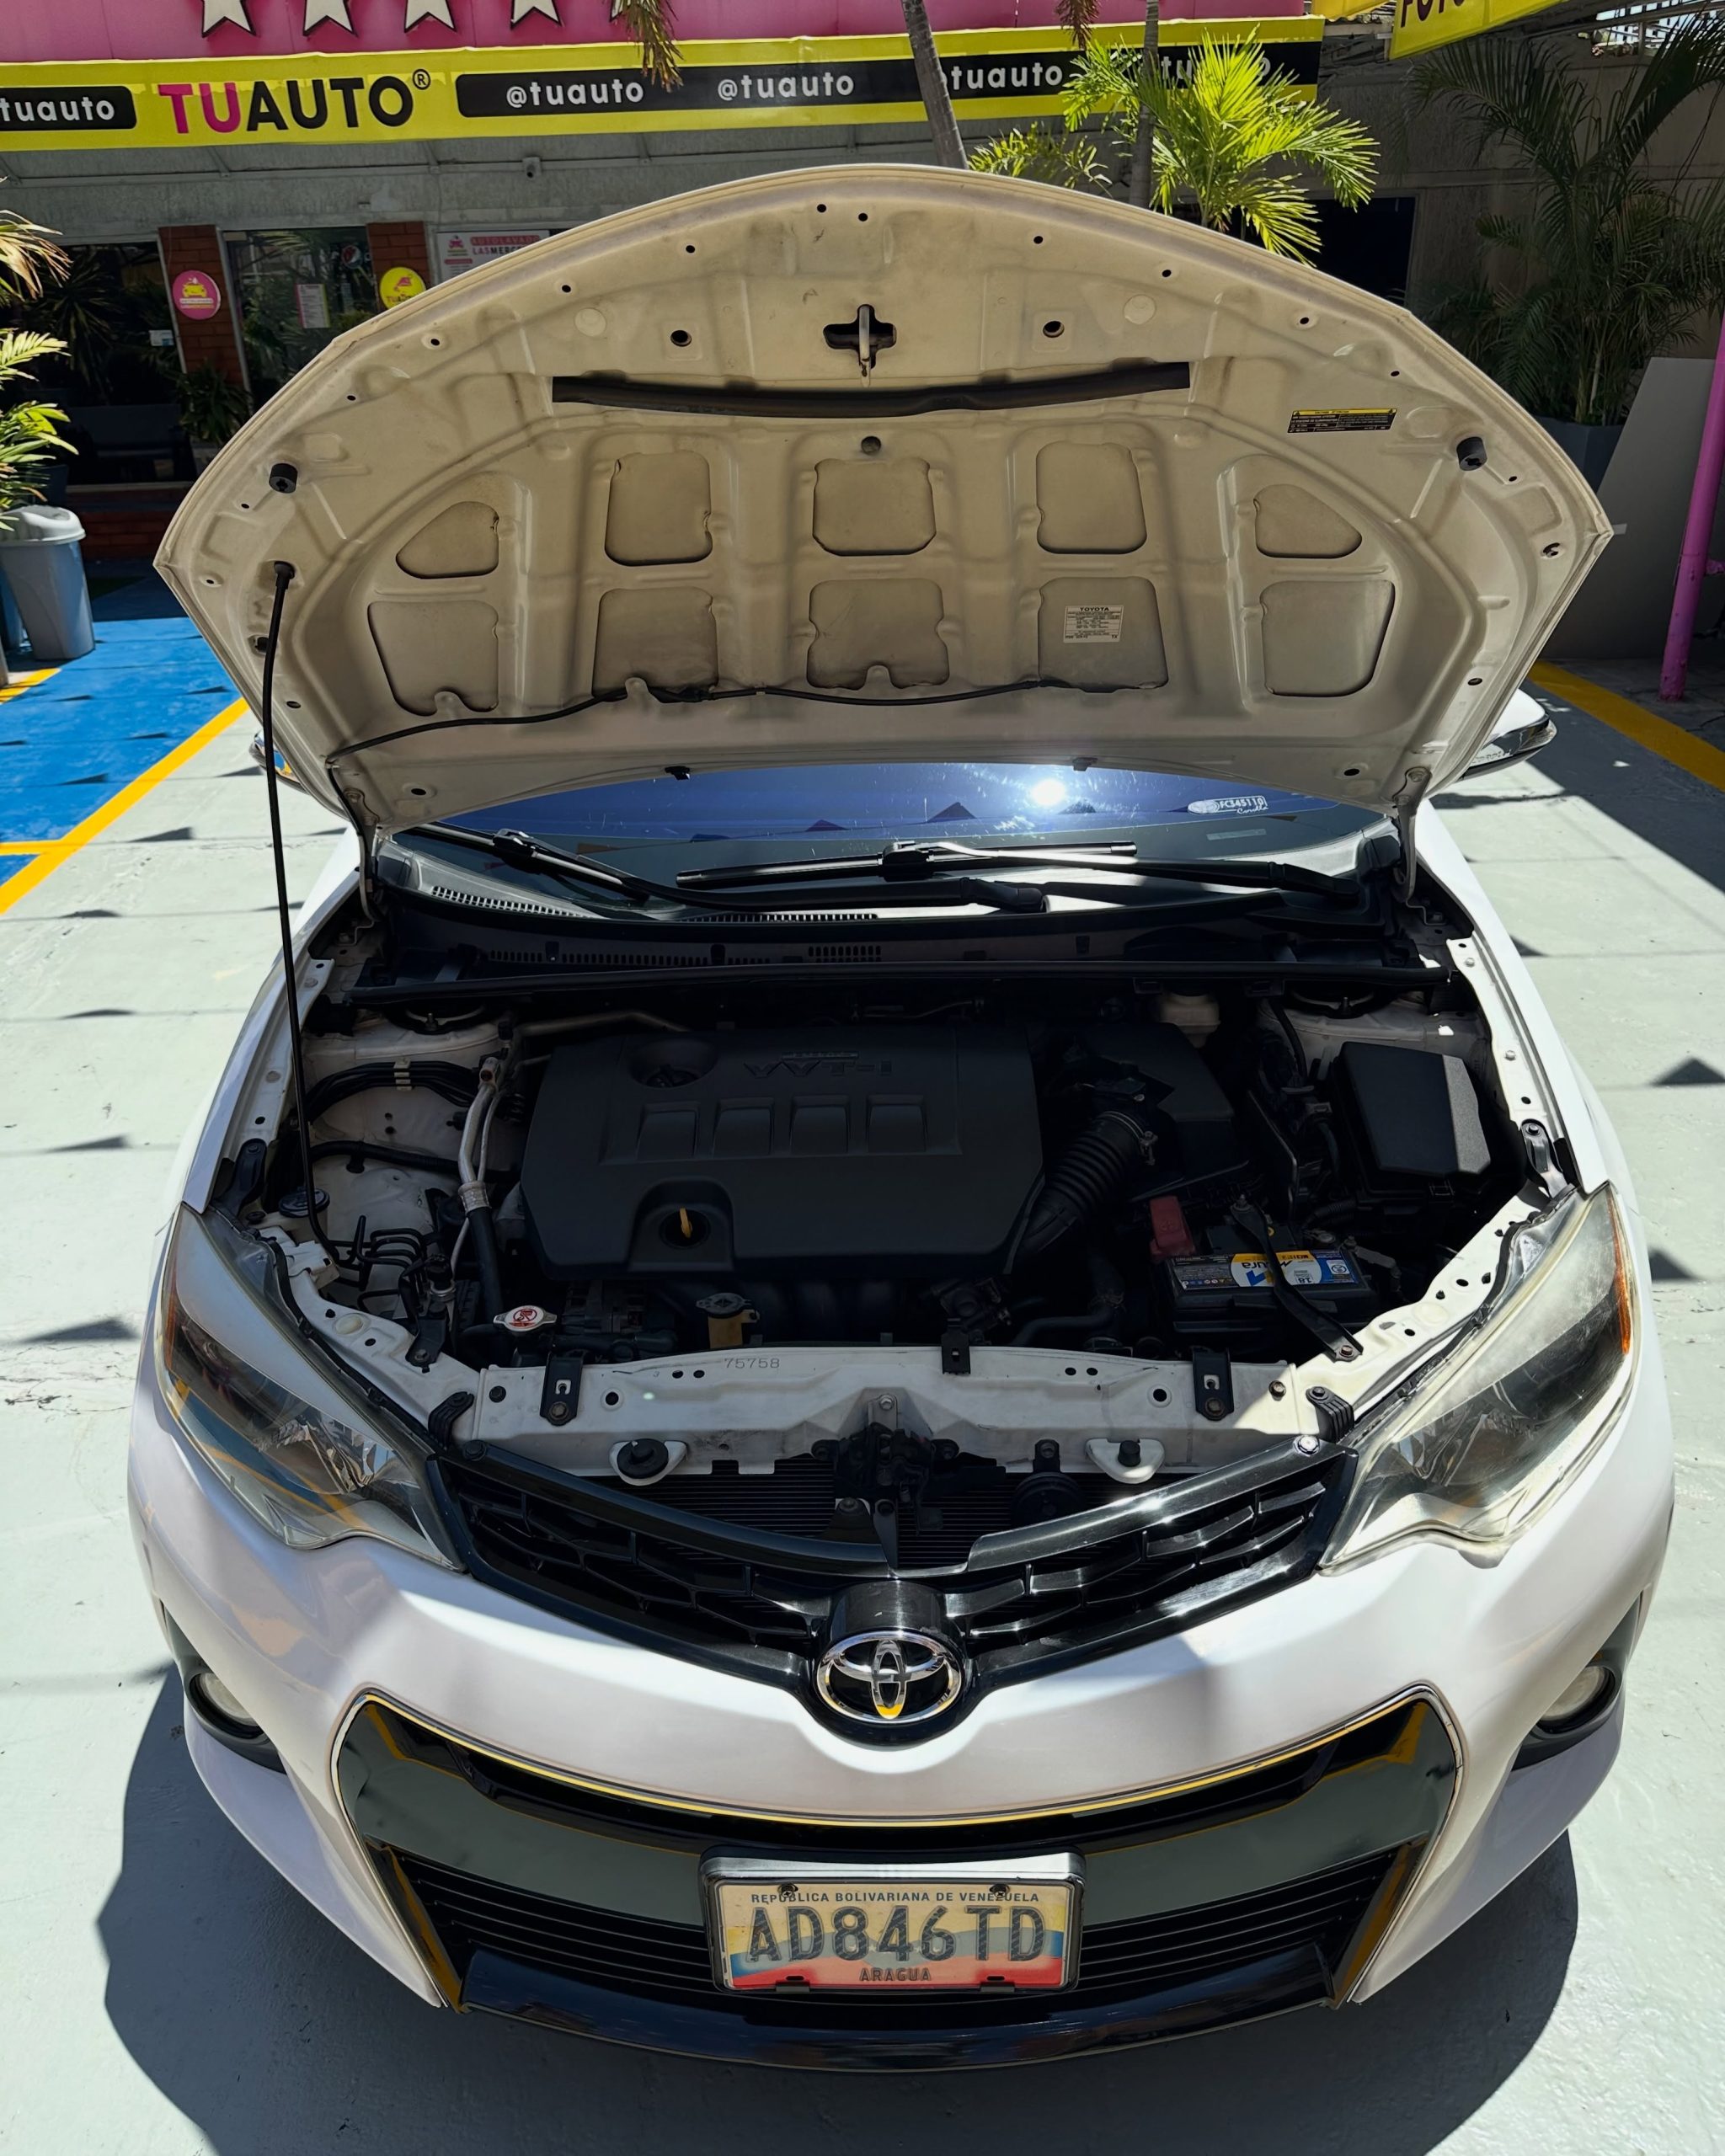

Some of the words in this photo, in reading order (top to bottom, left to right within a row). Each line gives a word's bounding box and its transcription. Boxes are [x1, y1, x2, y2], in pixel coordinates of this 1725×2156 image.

[942, 62, 1063, 90] tuauto
[506, 78, 644, 108] @tuauto
[718, 72, 854, 101] @tuauto
[1220, 798, 1263, 808] FC345110
[724, 1358, 780, 1369] 75758
[836, 1892, 930, 1902] BOLIVARIANA
[936, 1892, 953, 1902] DE
[859, 1967, 932, 1982] ARAGUA
